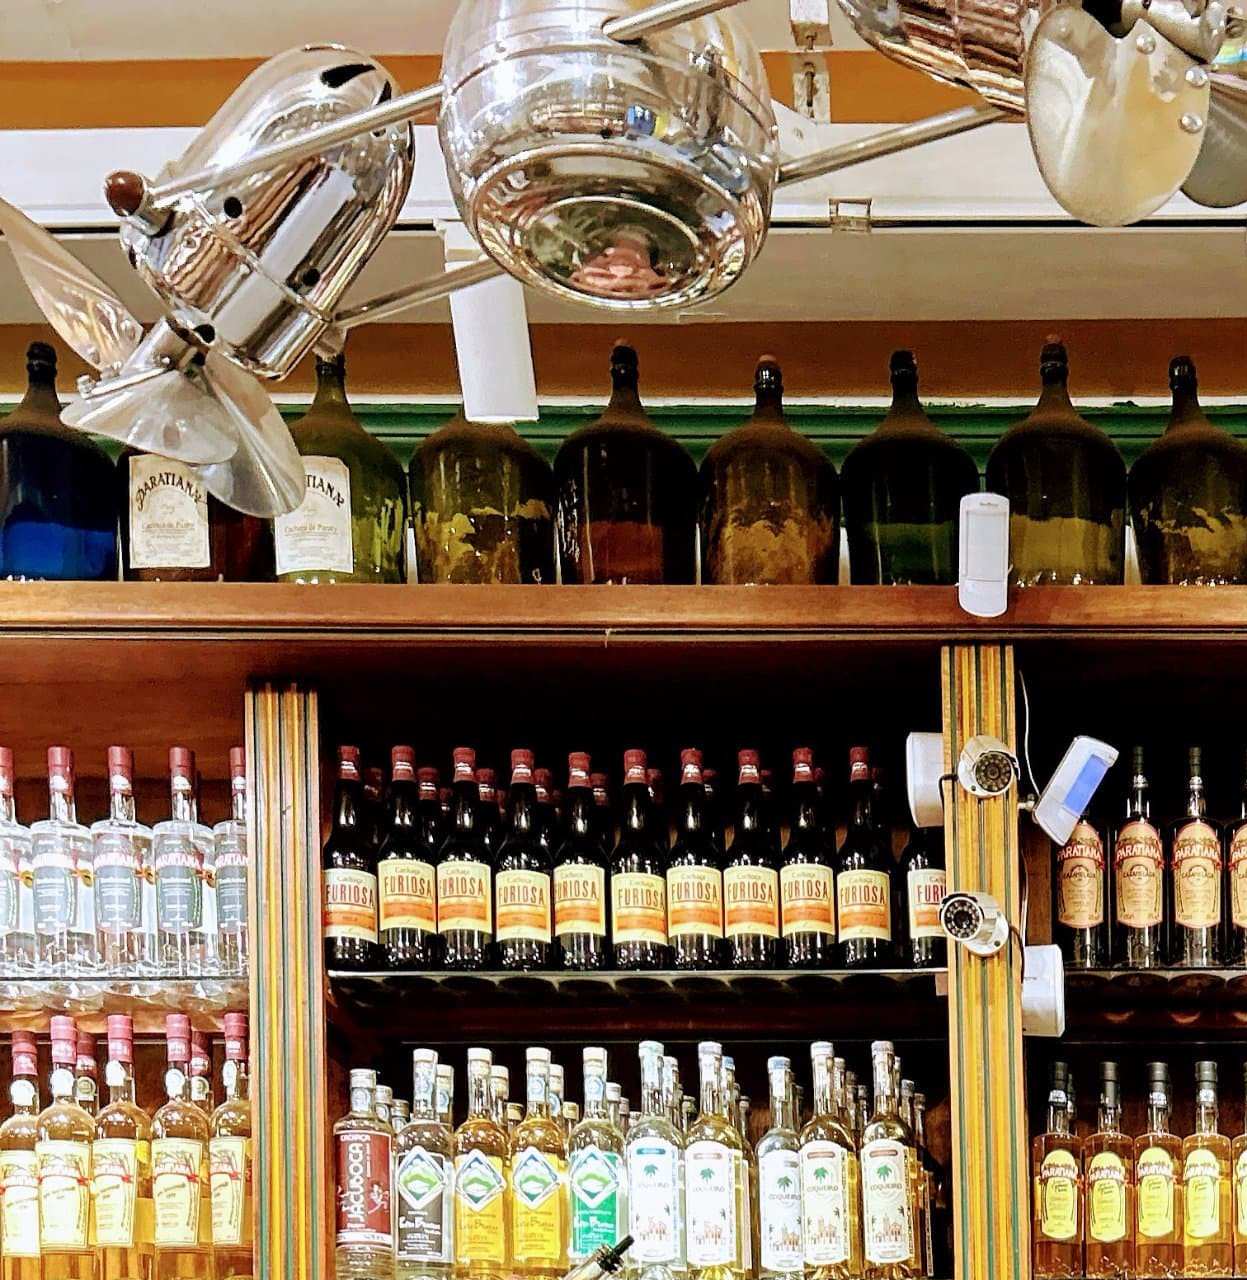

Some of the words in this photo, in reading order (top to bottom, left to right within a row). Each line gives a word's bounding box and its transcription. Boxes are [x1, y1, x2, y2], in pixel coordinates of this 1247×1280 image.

[136, 472, 202, 511] PARATIANA
[305, 474, 345, 508] TIANA
[326, 884, 374, 907] FURIOSA
[384, 875, 432, 898] FURIOSA
[438, 875, 484, 897] FURIOSA
[498, 884, 545, 905] FURIOSA
[554, 878, 597, 899] FURIOSA
[671, 880, 718, 902] FURIOSA
[727, 881, 774, 902] FURIOSA
[784, 879, 829, 900] FURIOSA
[840, 884, 886, 906] FURIOSA
[917, 884, 946, 905] FURI
[618, 888, 665, 911] FURIOSA
